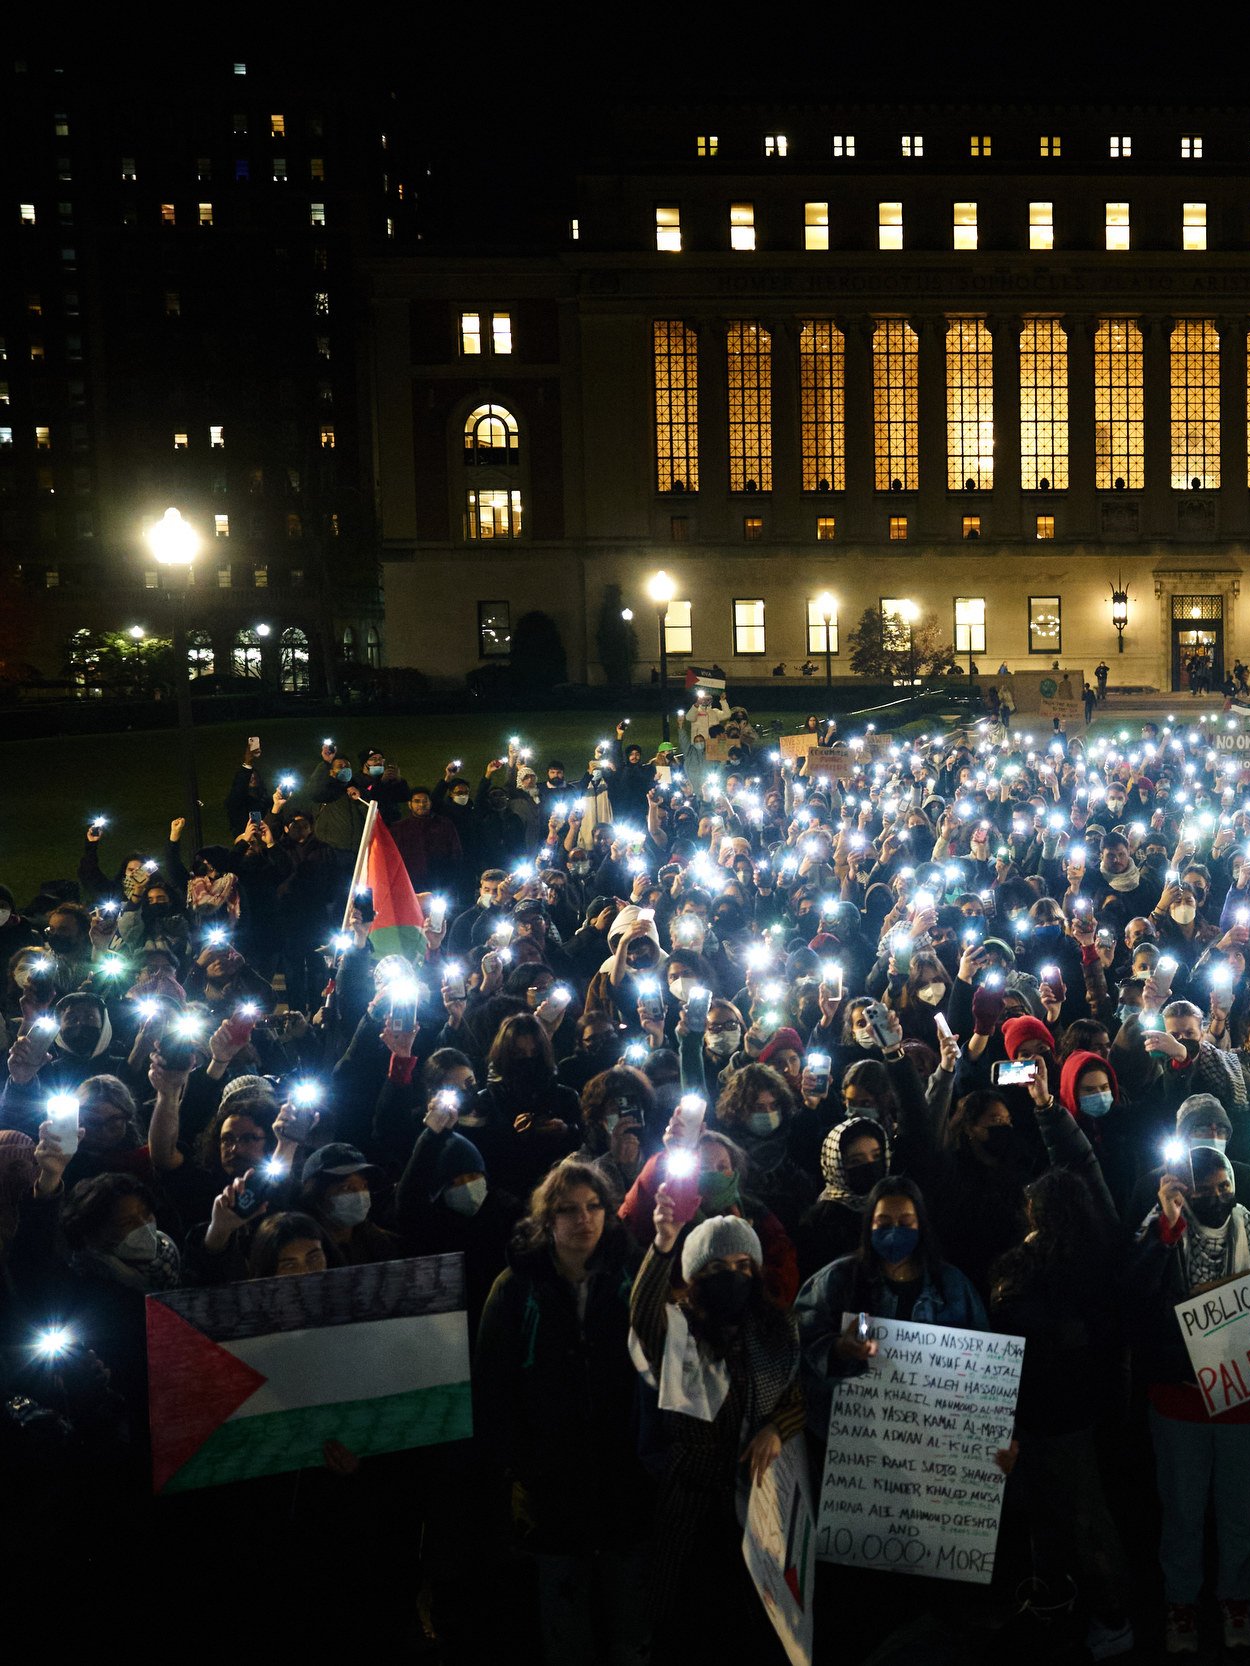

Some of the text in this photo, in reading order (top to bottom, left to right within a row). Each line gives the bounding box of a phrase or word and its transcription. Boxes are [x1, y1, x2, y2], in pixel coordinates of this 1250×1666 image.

[1216, 734, 1235, 750] NO
[896, 1328, 937, 1346] HAMID
[941, 1333, 984, 1352] NASSER
[884, 1347, 923, 1364] YAHYA
[929, 1353, 962, 1370] YUSUF
[837, 1383, 879, 1400] FATIMA
[883, 1388, 930, 1407] KHALIL
[890, 1370, 920, 1387] ALI
[922, 1375, 959, 1393] SALEH
[964, 1380, 1019, 1399] HASSOUNA
[881, 1405, 919, 1424] YASSER
[923, 1414, 957, 1430] KAMAL
[830, 1421, 877, 1439] SANAA
[828, 1449, 877, 1468] RAHAF
[825, 1472, 870, 1490] AMAL
[970, 1490, 1001, 1505] MUSA
[823, 1499, 863, 1514] MIRNA
[953, 1513, 999, 1531] QESHTA
[888, 1522, 920, 1538] AND
[936, 1545, 996, 1574] MORE
